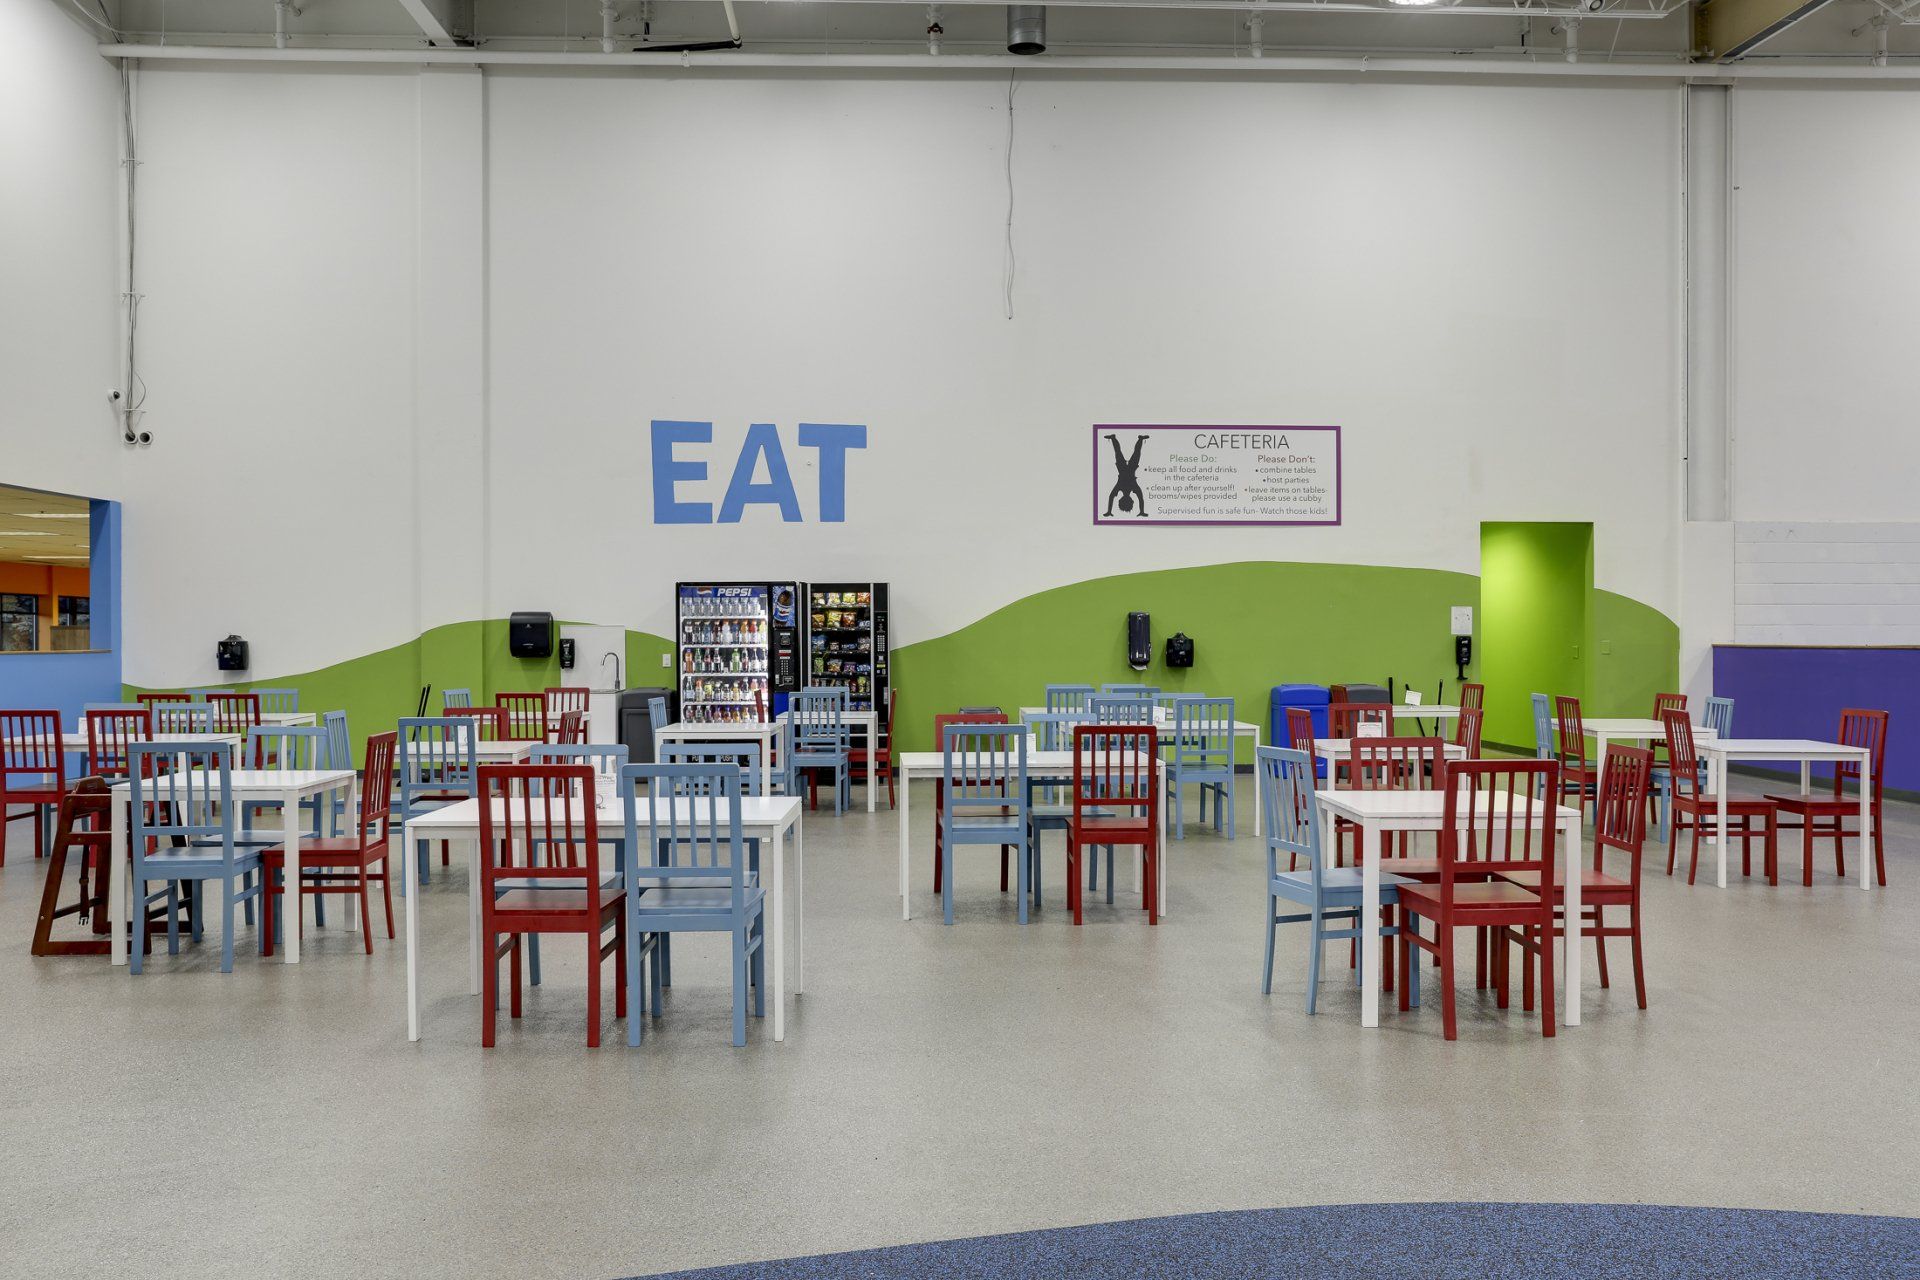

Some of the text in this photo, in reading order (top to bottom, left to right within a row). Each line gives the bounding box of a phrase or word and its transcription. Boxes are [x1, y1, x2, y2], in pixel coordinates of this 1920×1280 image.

[1194, 434, 1290, 449] CAFETERIA
[1170, 454, 1217, 463] Please Do:
[1258, 455, 1316, 464] Please Don't:
[652, 421, 867, 524] EAT
[1148, 466, 1166, 475] keep
[1187, 474, 1218, 482] cafeteria
[1285, 477, 1309, 485] parties
[1150, 484, 1170, 492] clean
[1184, 484, 1201, 492] after
[1203, 484, 1234, 493] yourself!
[1148, 493, 1237, 501] brooms/wipes provided
[1251, 494, 1276, 503] please
[1299, 494, 1321, 503] cubby
[1158, 507, 1200, 516] Supervised
[1202, 507, 1215, 515] fun
[1218, 507, 1224, 515] is
[1226, 507, 1241, 515] safe
[1260, 507, 1283, 515] Watch
[1286, 507, 1308, 515] those
[1310, 507, 1328, 515] kids!
[717, 588, 752, 597] PEPSI
